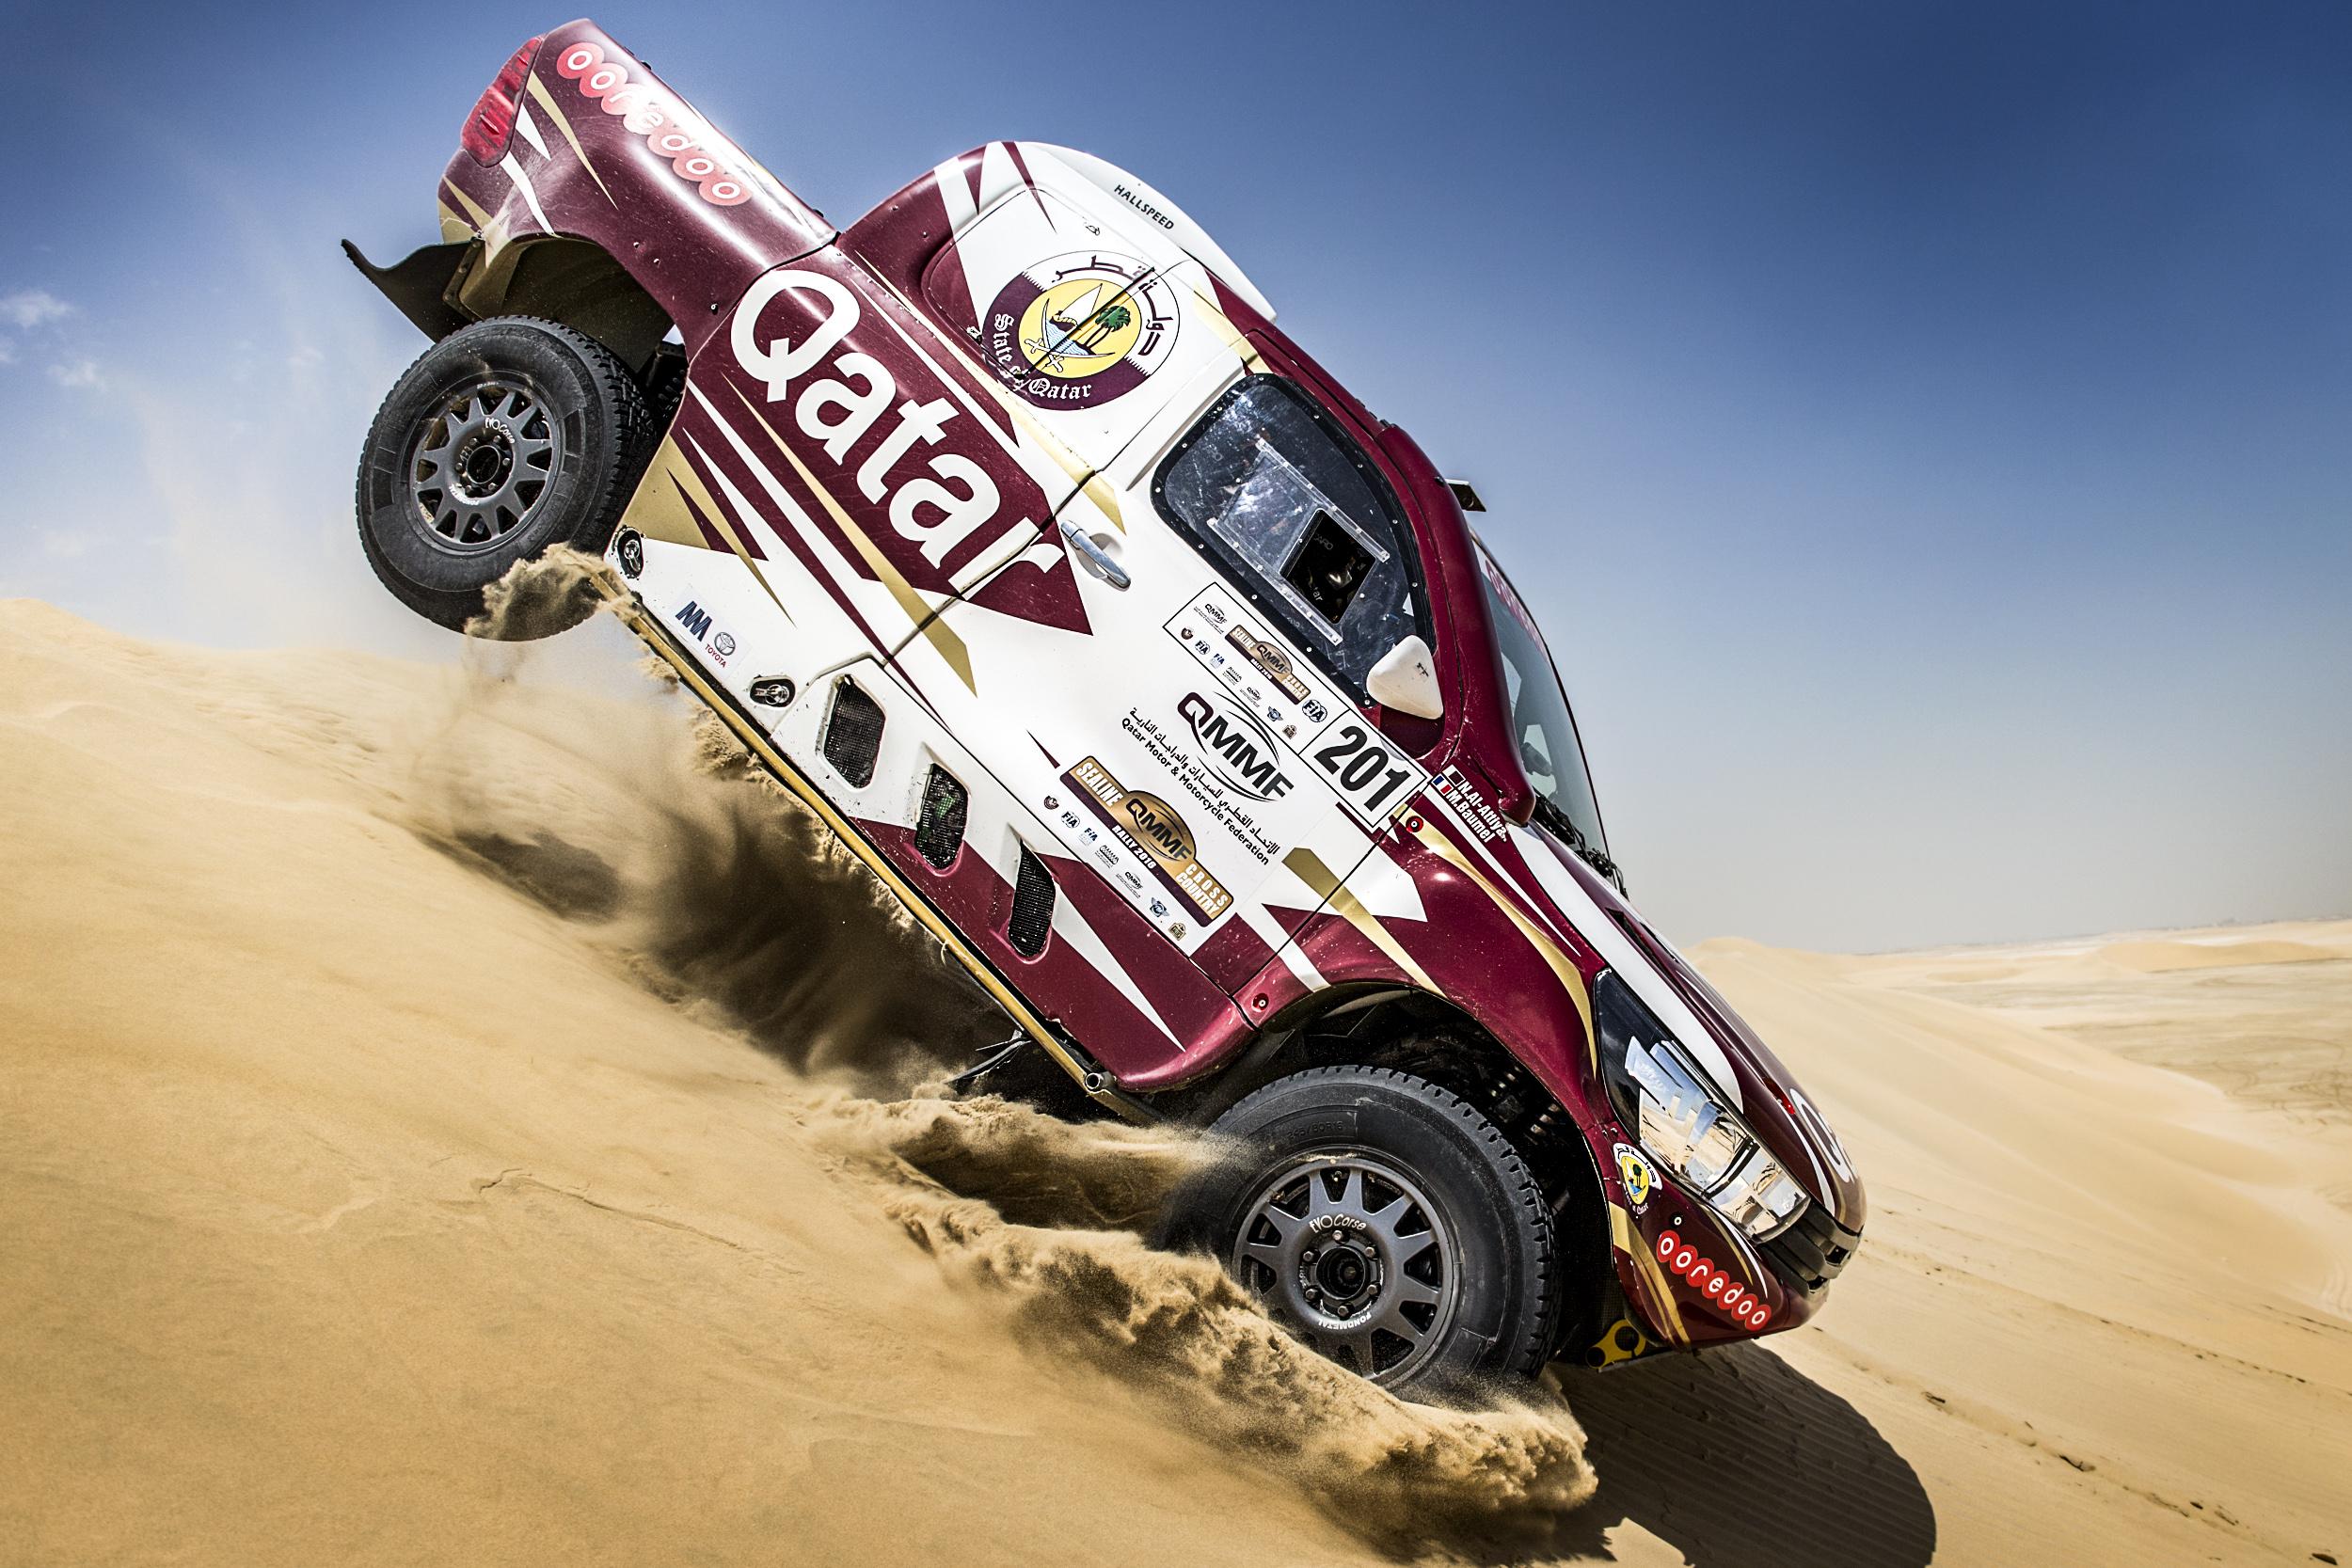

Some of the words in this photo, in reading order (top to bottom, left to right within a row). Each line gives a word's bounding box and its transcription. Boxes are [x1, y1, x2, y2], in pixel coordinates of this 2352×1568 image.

[1114, 184, 1174, 230] HALLSPEED
[993, 313, 1015, 363] State
[1028, 377, 1092, 400] Qatar
[730, 269, 1065, 600] Qatar
[1204, 603, 1228, 625] QMMF
[705, 643, 727, 669] TOYOTA
[1257, 644, 1291, 673] QMMF
[1177, 691, 1295, 798] QMMF
[1075, 761, 1124, 808] SEALINE
[1121, 717, 1146, 743] Qatar
[1145, 740, 1172, 768] Motor
[1170, 766, 1179, 777] &
[1179, 772, 1224, 821] Motorcycle
[1223, 818, 1269, 865] Federation
[1313, 725, 1412, 813] 201
[1125, 798, 1192, 861] QMMF
[1446, 791, 1496, 843] M.Baumel
[1111, 824, 1139, 851] RALLY
[1134, 847, 1157, 870] 2016
[1124, 871, 1143, 890] QMMF
[1176, 872, 1220, 917] COUNTRY
[1185, 863, 1229, 908] CROSS
[1660, 1237, 1765, 1324] ooredoo
[1317, 1311, 1372, 1330] FONDMETAL
